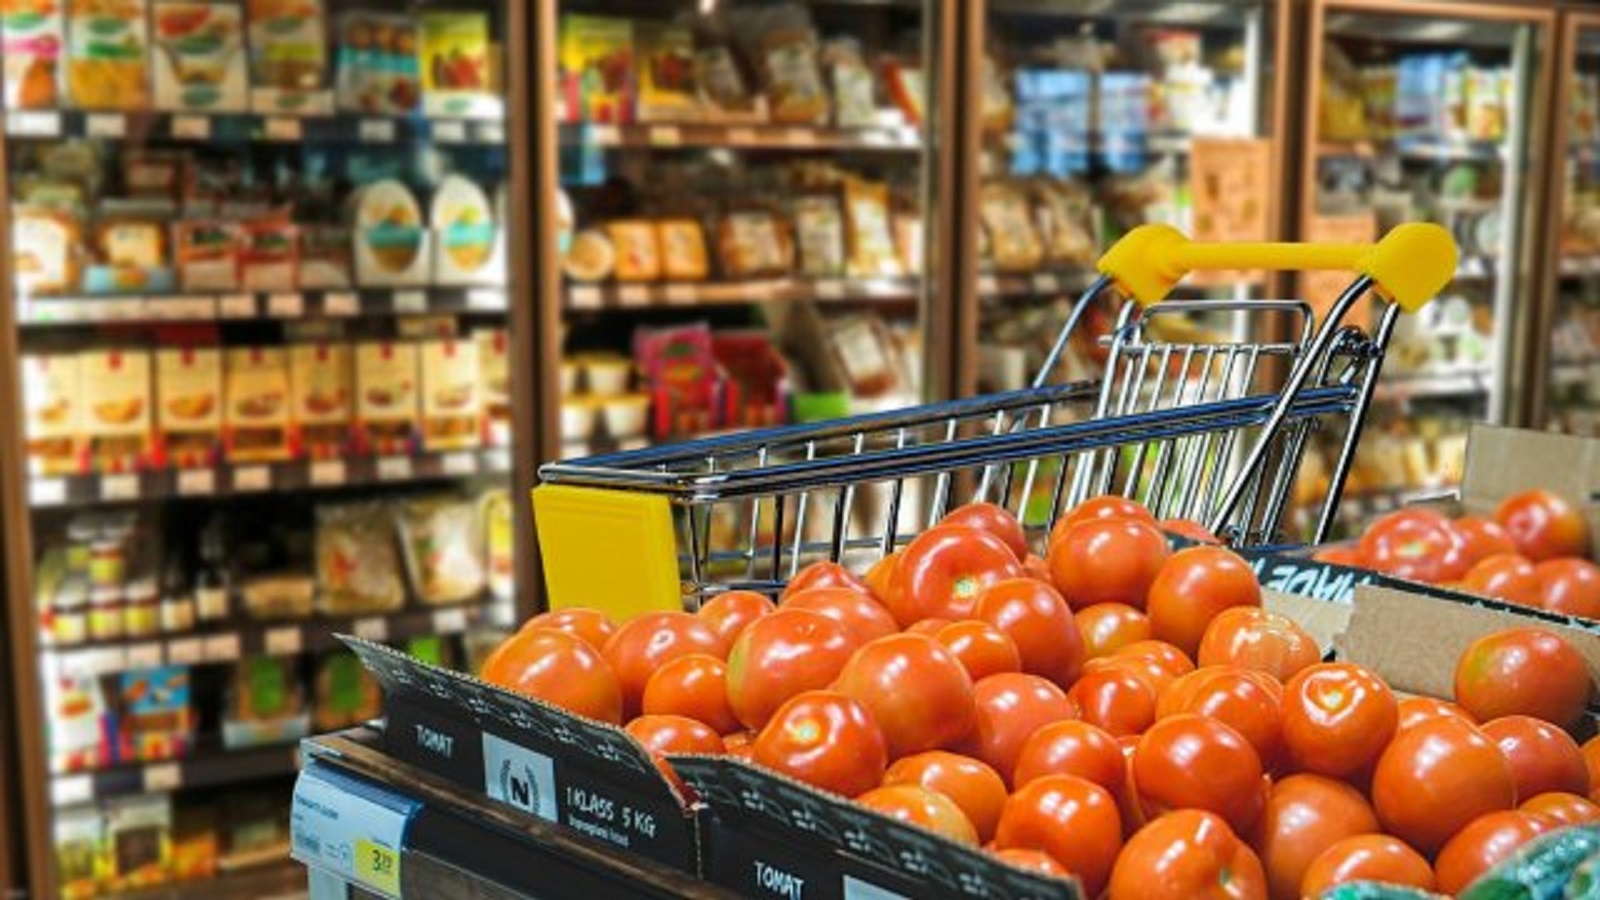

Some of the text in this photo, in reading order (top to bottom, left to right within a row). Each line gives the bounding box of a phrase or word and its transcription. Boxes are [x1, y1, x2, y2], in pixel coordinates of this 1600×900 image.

[415, 724, 454, 758] TOMAT
[510, 775, 529, 806] N
[574, 788, 614, 821] KLASS
[622, 806, 631, 828] 5
[634, 810, 656, 838] KG
[754, 860, 804, 900] TOMAT
